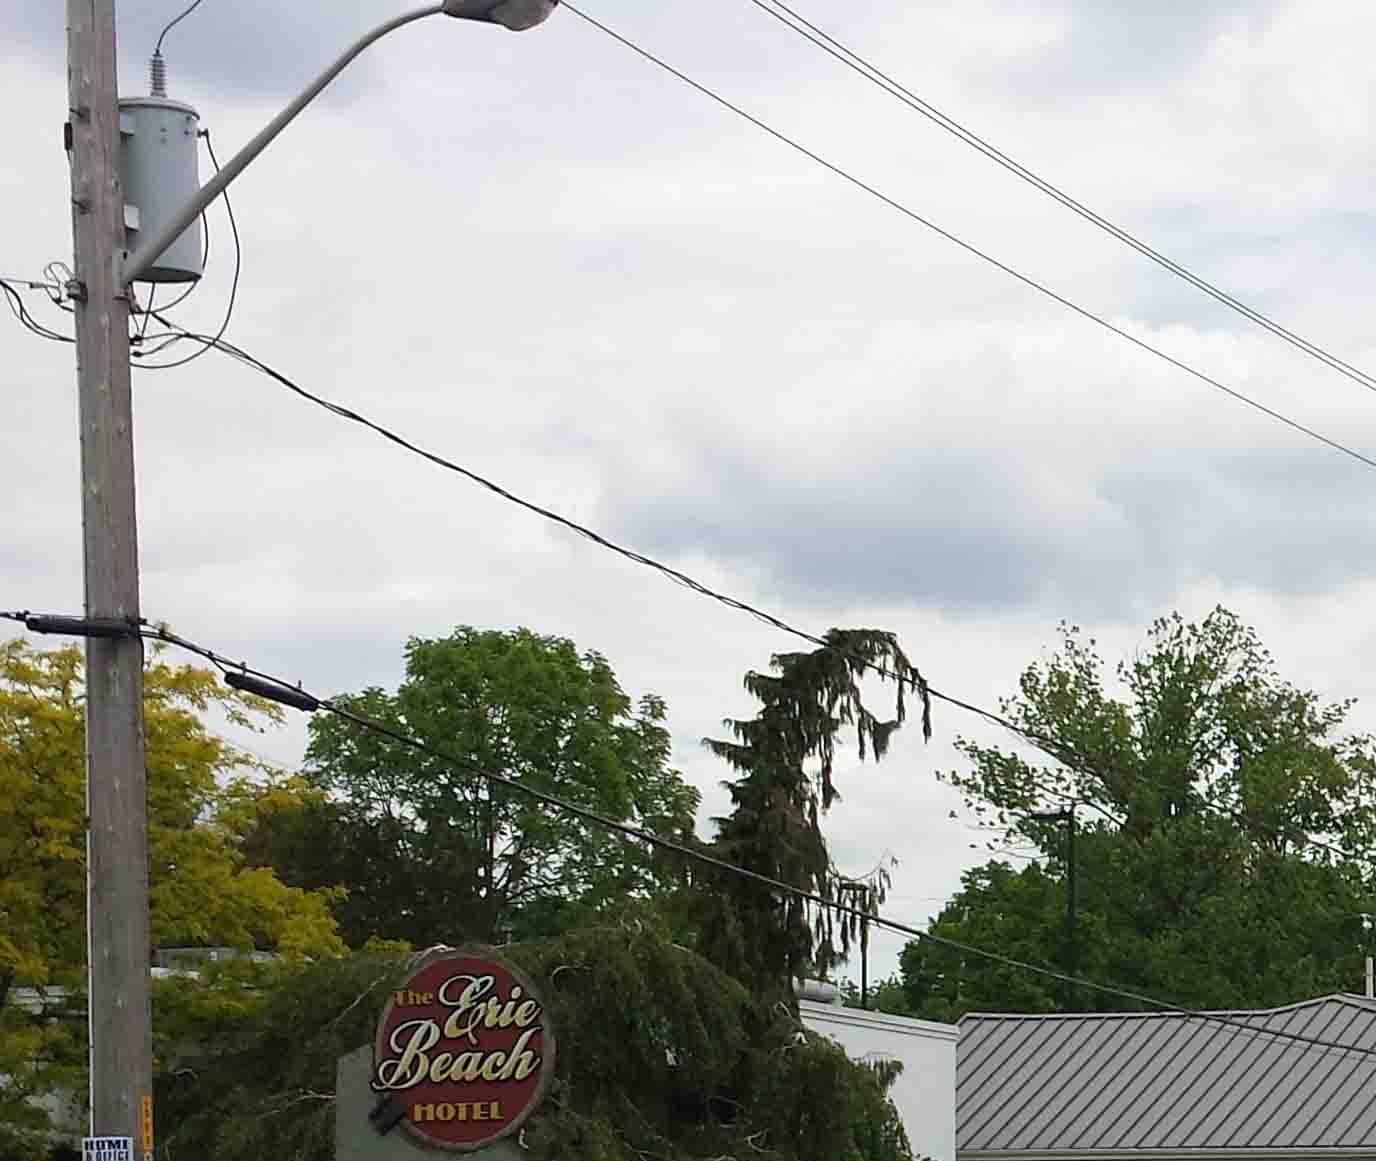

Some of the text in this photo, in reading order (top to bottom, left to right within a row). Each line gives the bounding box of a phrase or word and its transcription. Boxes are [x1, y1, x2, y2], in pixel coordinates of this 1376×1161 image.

[393, 974, 544, 1045] The Erie
[370, 1019, 543, 1091] Beach
[413, 1101, 505, 1121] HOTEL
